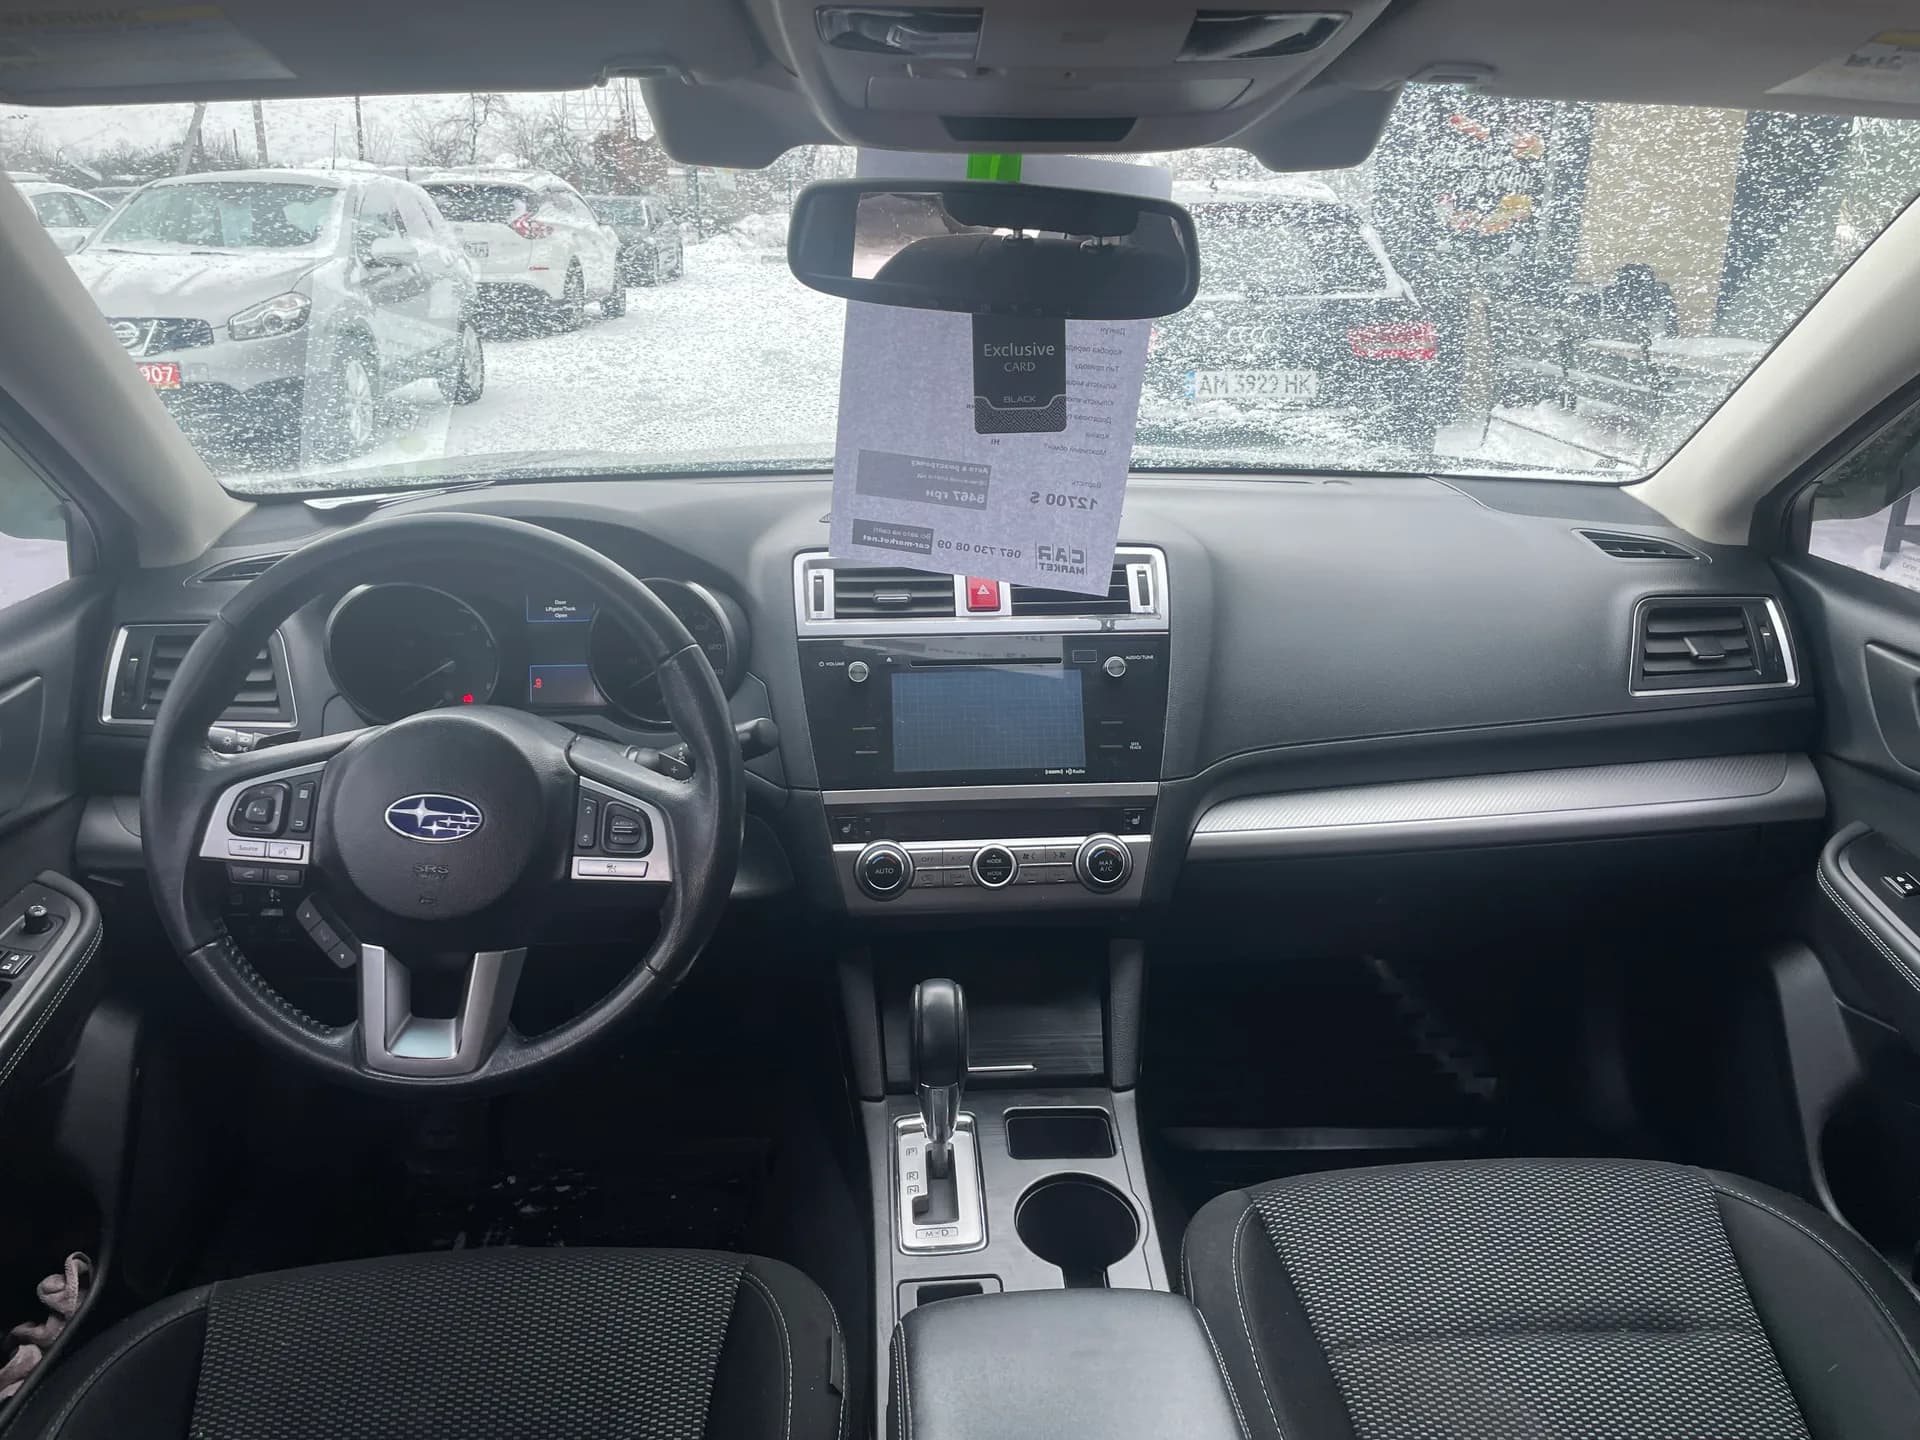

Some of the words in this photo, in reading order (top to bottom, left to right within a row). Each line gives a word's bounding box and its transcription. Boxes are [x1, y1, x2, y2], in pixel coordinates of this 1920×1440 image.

[984, 342, 1055, 357] Exclusive
[1004, 362, 1036, 372] CARD
[1003, 395, 1036, 403] BLACK
[415, 864, 449, 873] SRS
